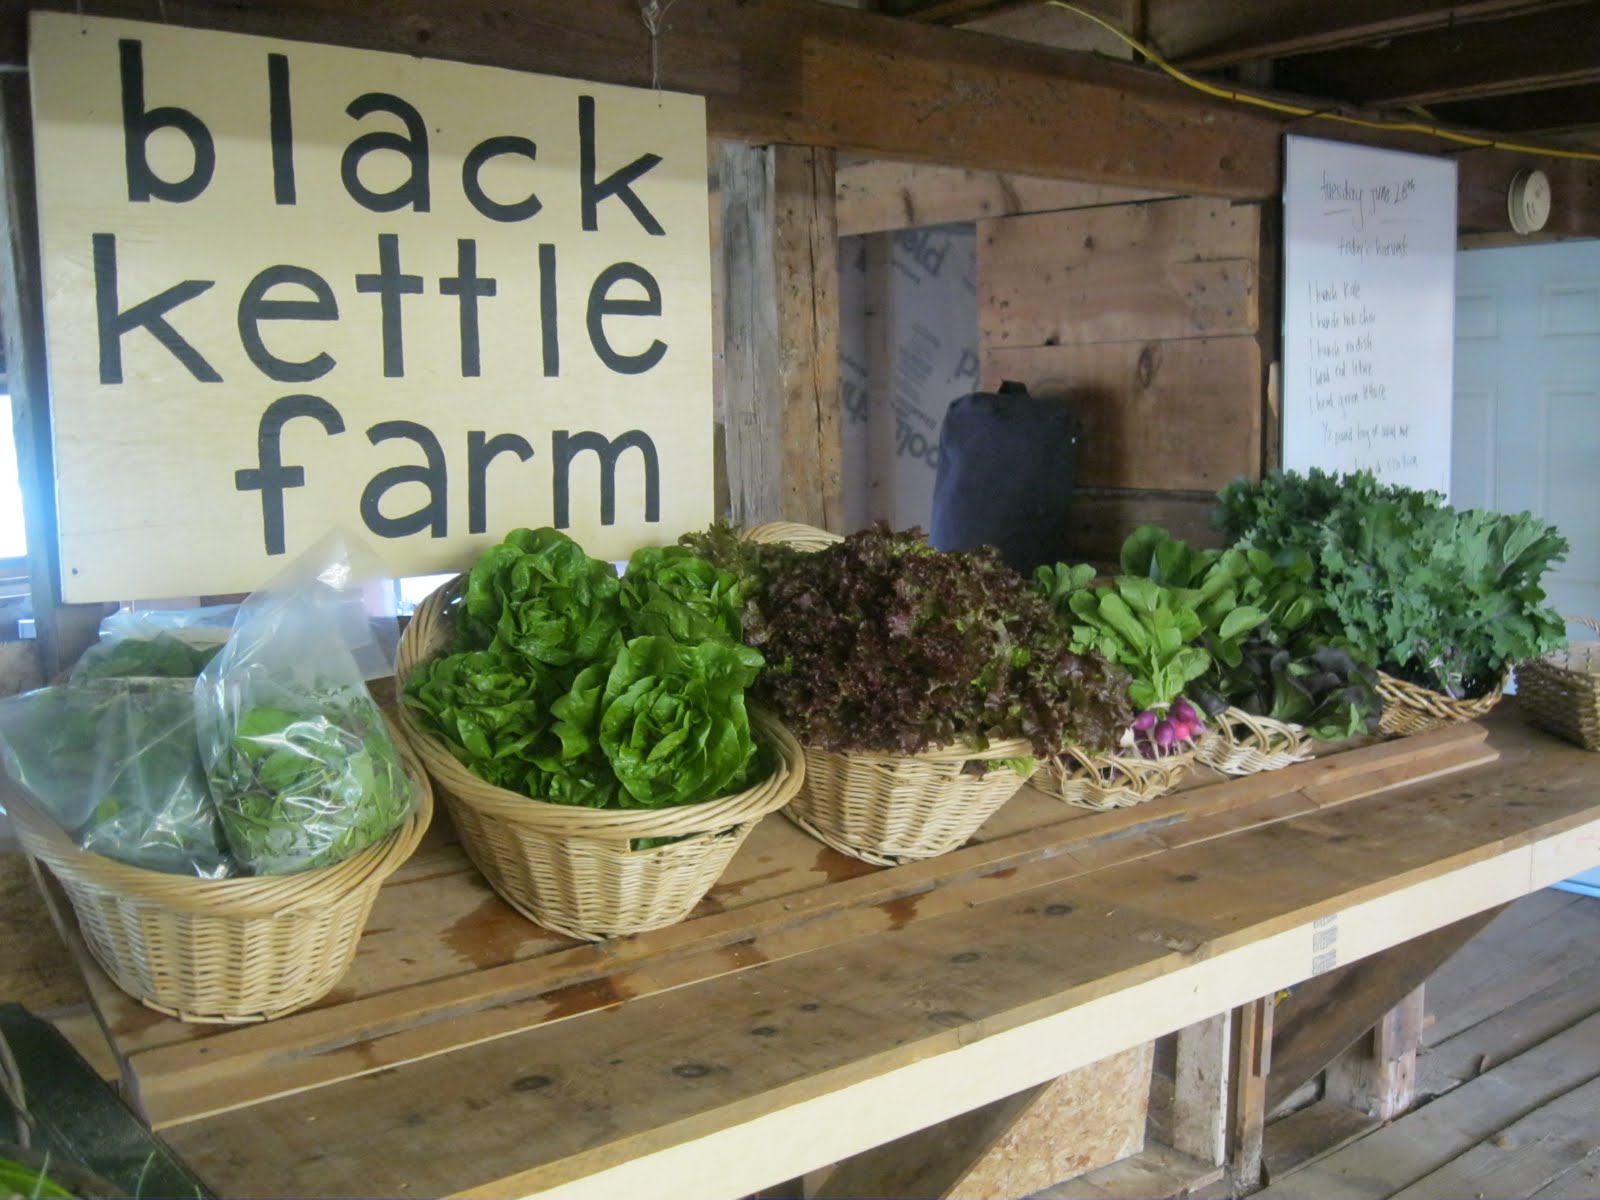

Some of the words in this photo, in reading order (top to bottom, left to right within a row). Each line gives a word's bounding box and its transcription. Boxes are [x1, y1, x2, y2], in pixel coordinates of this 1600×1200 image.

[118, 38, 667, 236] black
[1320, 170, 1364, 232] tuesday
[92, 232, 669, 385] kettle
[234, 393, 661, 556] farm
